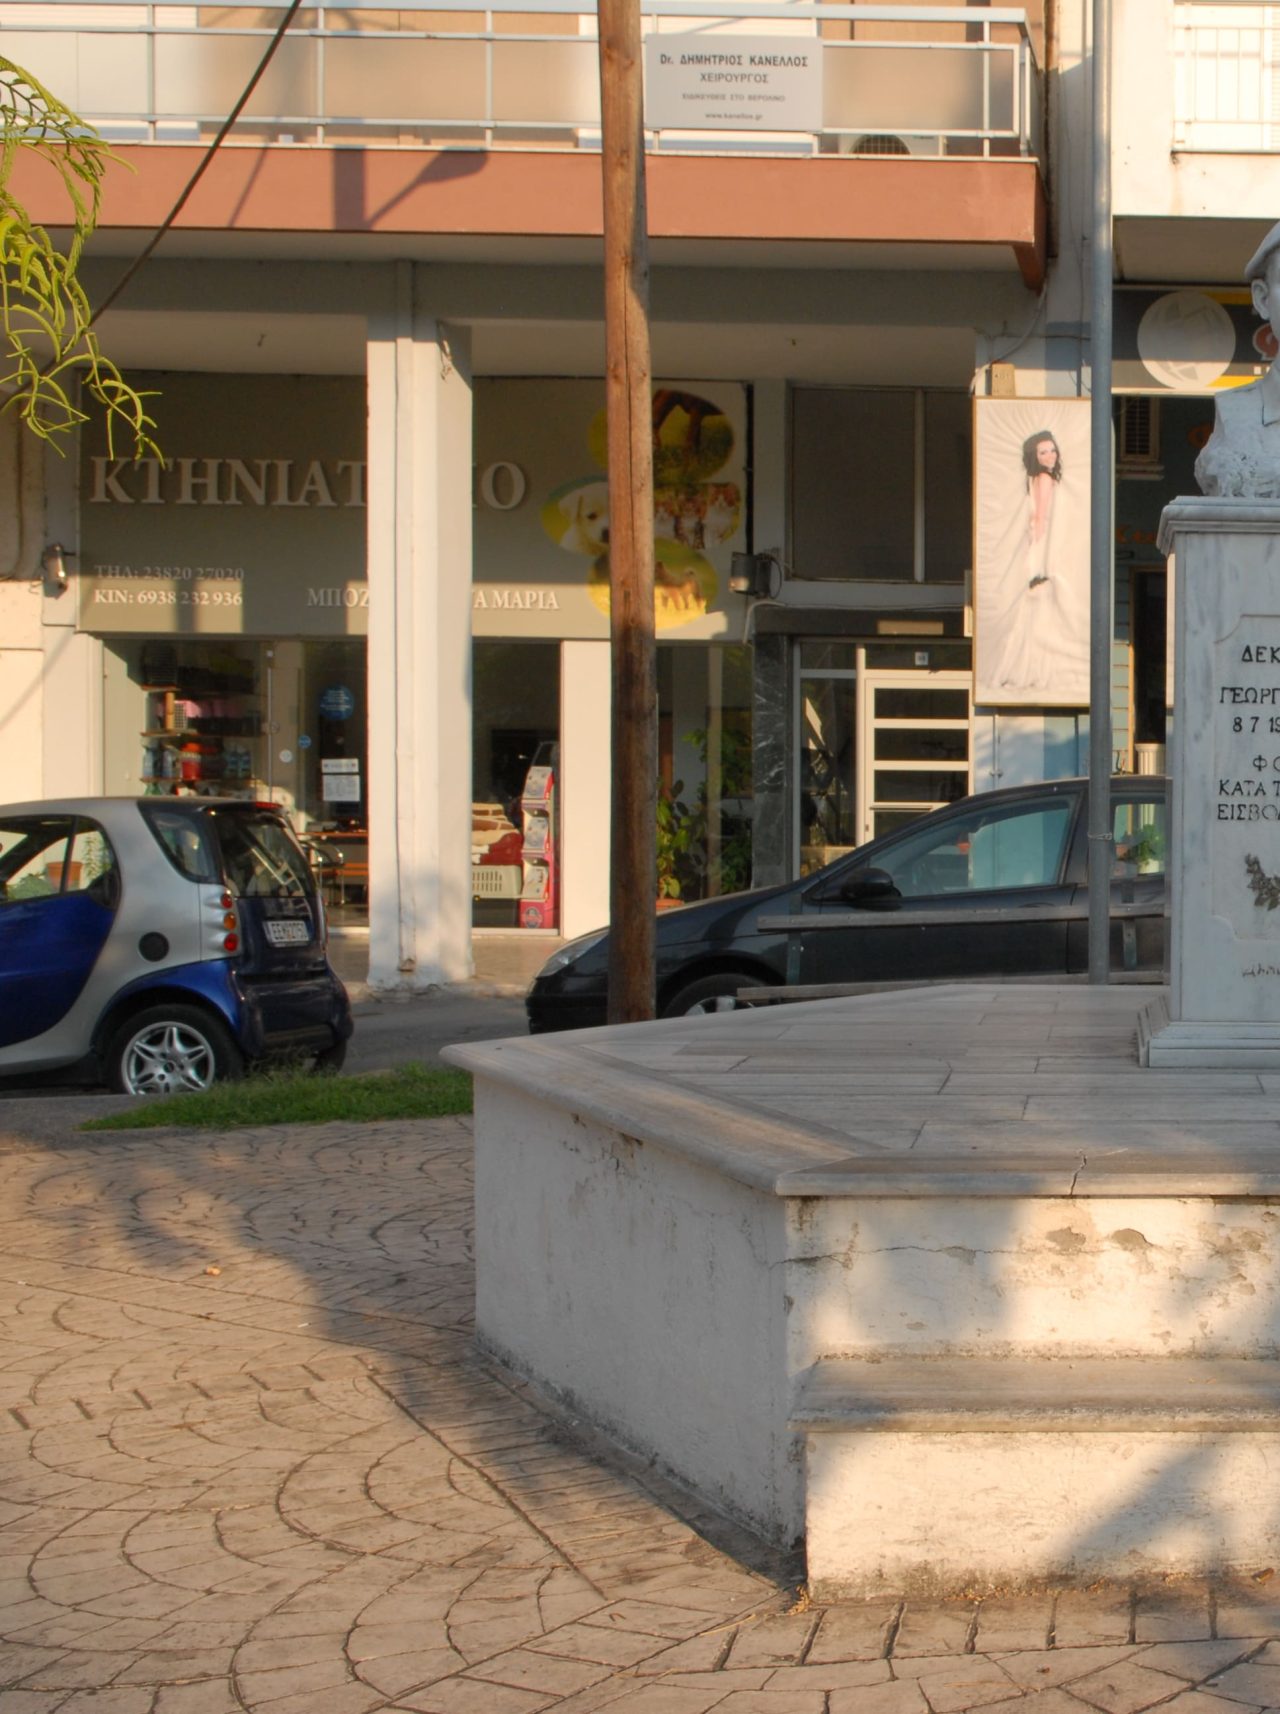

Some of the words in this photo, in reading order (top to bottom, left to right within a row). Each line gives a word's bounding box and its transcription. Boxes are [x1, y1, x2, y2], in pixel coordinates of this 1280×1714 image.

[660, 54, 674, 65] Dr.
[680, 54, 743, 66] ΔΗΜΗΤΡΙΟΣ
[749, 56, 808, 67] ΚΑΝΕΛΛΟΣ
[700, 72, 768, 84] ΧΕΙΡΟΥΡΓΟΣ
[94, 565, 138, 579] ΤΗΛ:
[143, 566, 191, 580] 23820
[196, 567, 244, 581] 27020
[94, 590, 133, 605] ΚΙΝ:
[137, 590, 176, 605] 6938
[181, 591, 209, 605] 232
[213, 591, 242, 606] 936
[493, 589, 559, 609] ΜΑΡΙΑ
[1232, 716, 1243, 733] 8
[1250, 716, 1260, 733] 7
[1218, 779, 1266, 797] ΚΑΤΑ
